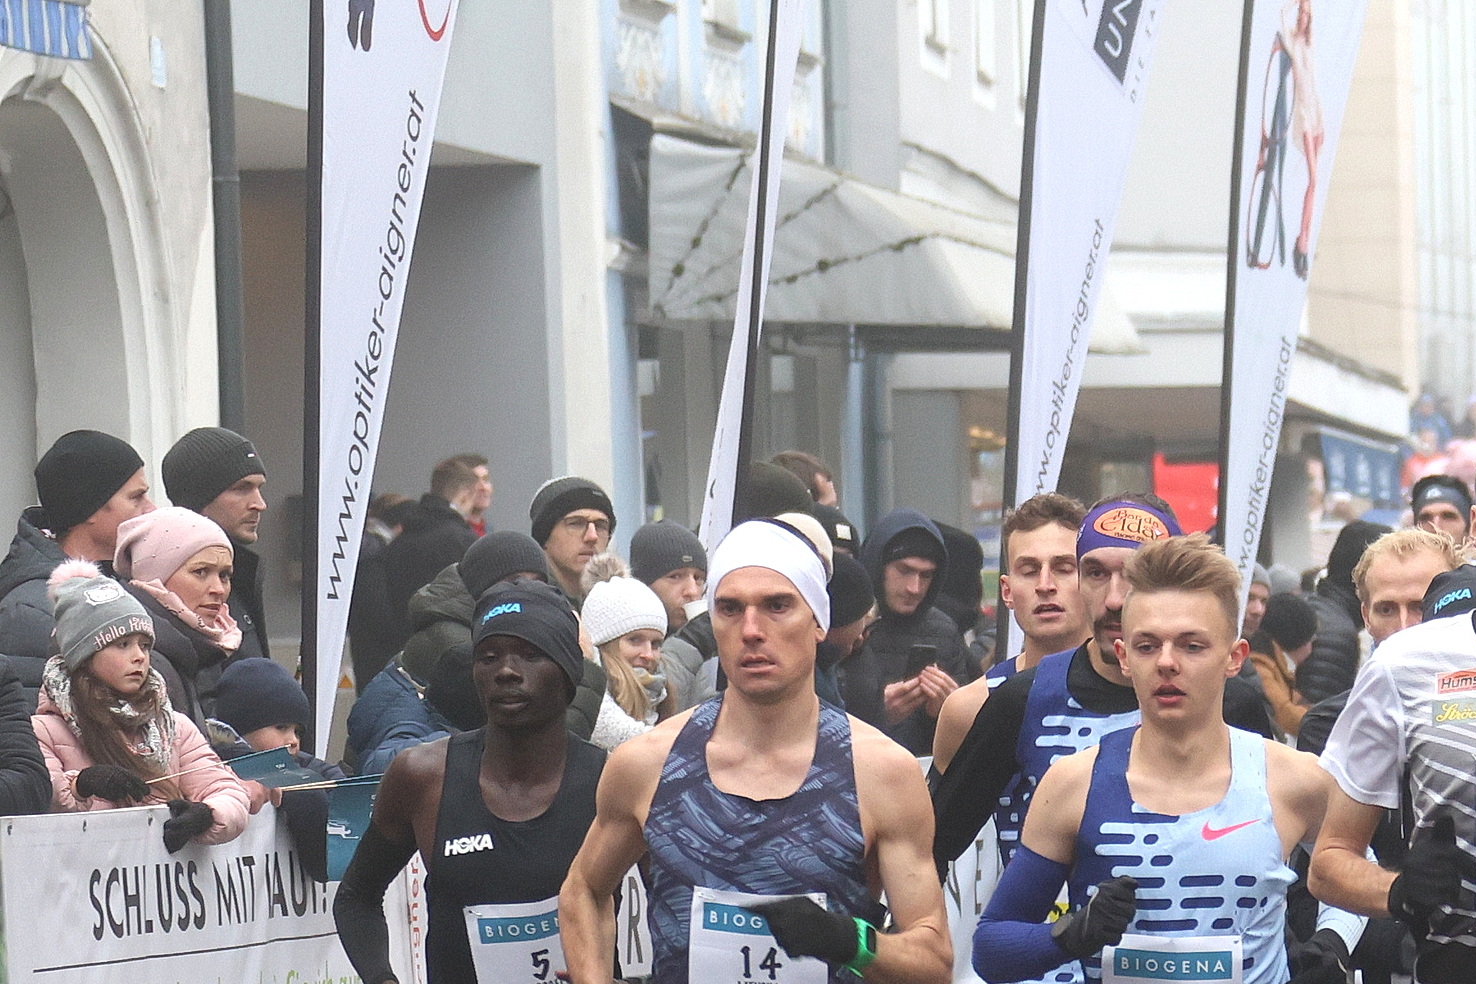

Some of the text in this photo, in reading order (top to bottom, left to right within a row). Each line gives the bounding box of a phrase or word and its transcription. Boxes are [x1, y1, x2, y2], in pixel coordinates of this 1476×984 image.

[327, 89, 425, 600] www.optiker-aigner.at
[1035, 218, 1105, 496] ww.optiker-aigner.at
[1238, 335, 1292, 571] w.optiker-aigner.at
[1433, 588, 1472, 615] HOKA
[93, 625, 126, 651] Hello
[444, 834, 494, 857] HOKA
[89, 860, 206, 941] SCHLUSS
[213, 855, 255, 926] MIT
[531, 949, 551, 981] 5
[740, 946, 783, 981] 14
[1121, 957, 1225, 974] BIOGENA
